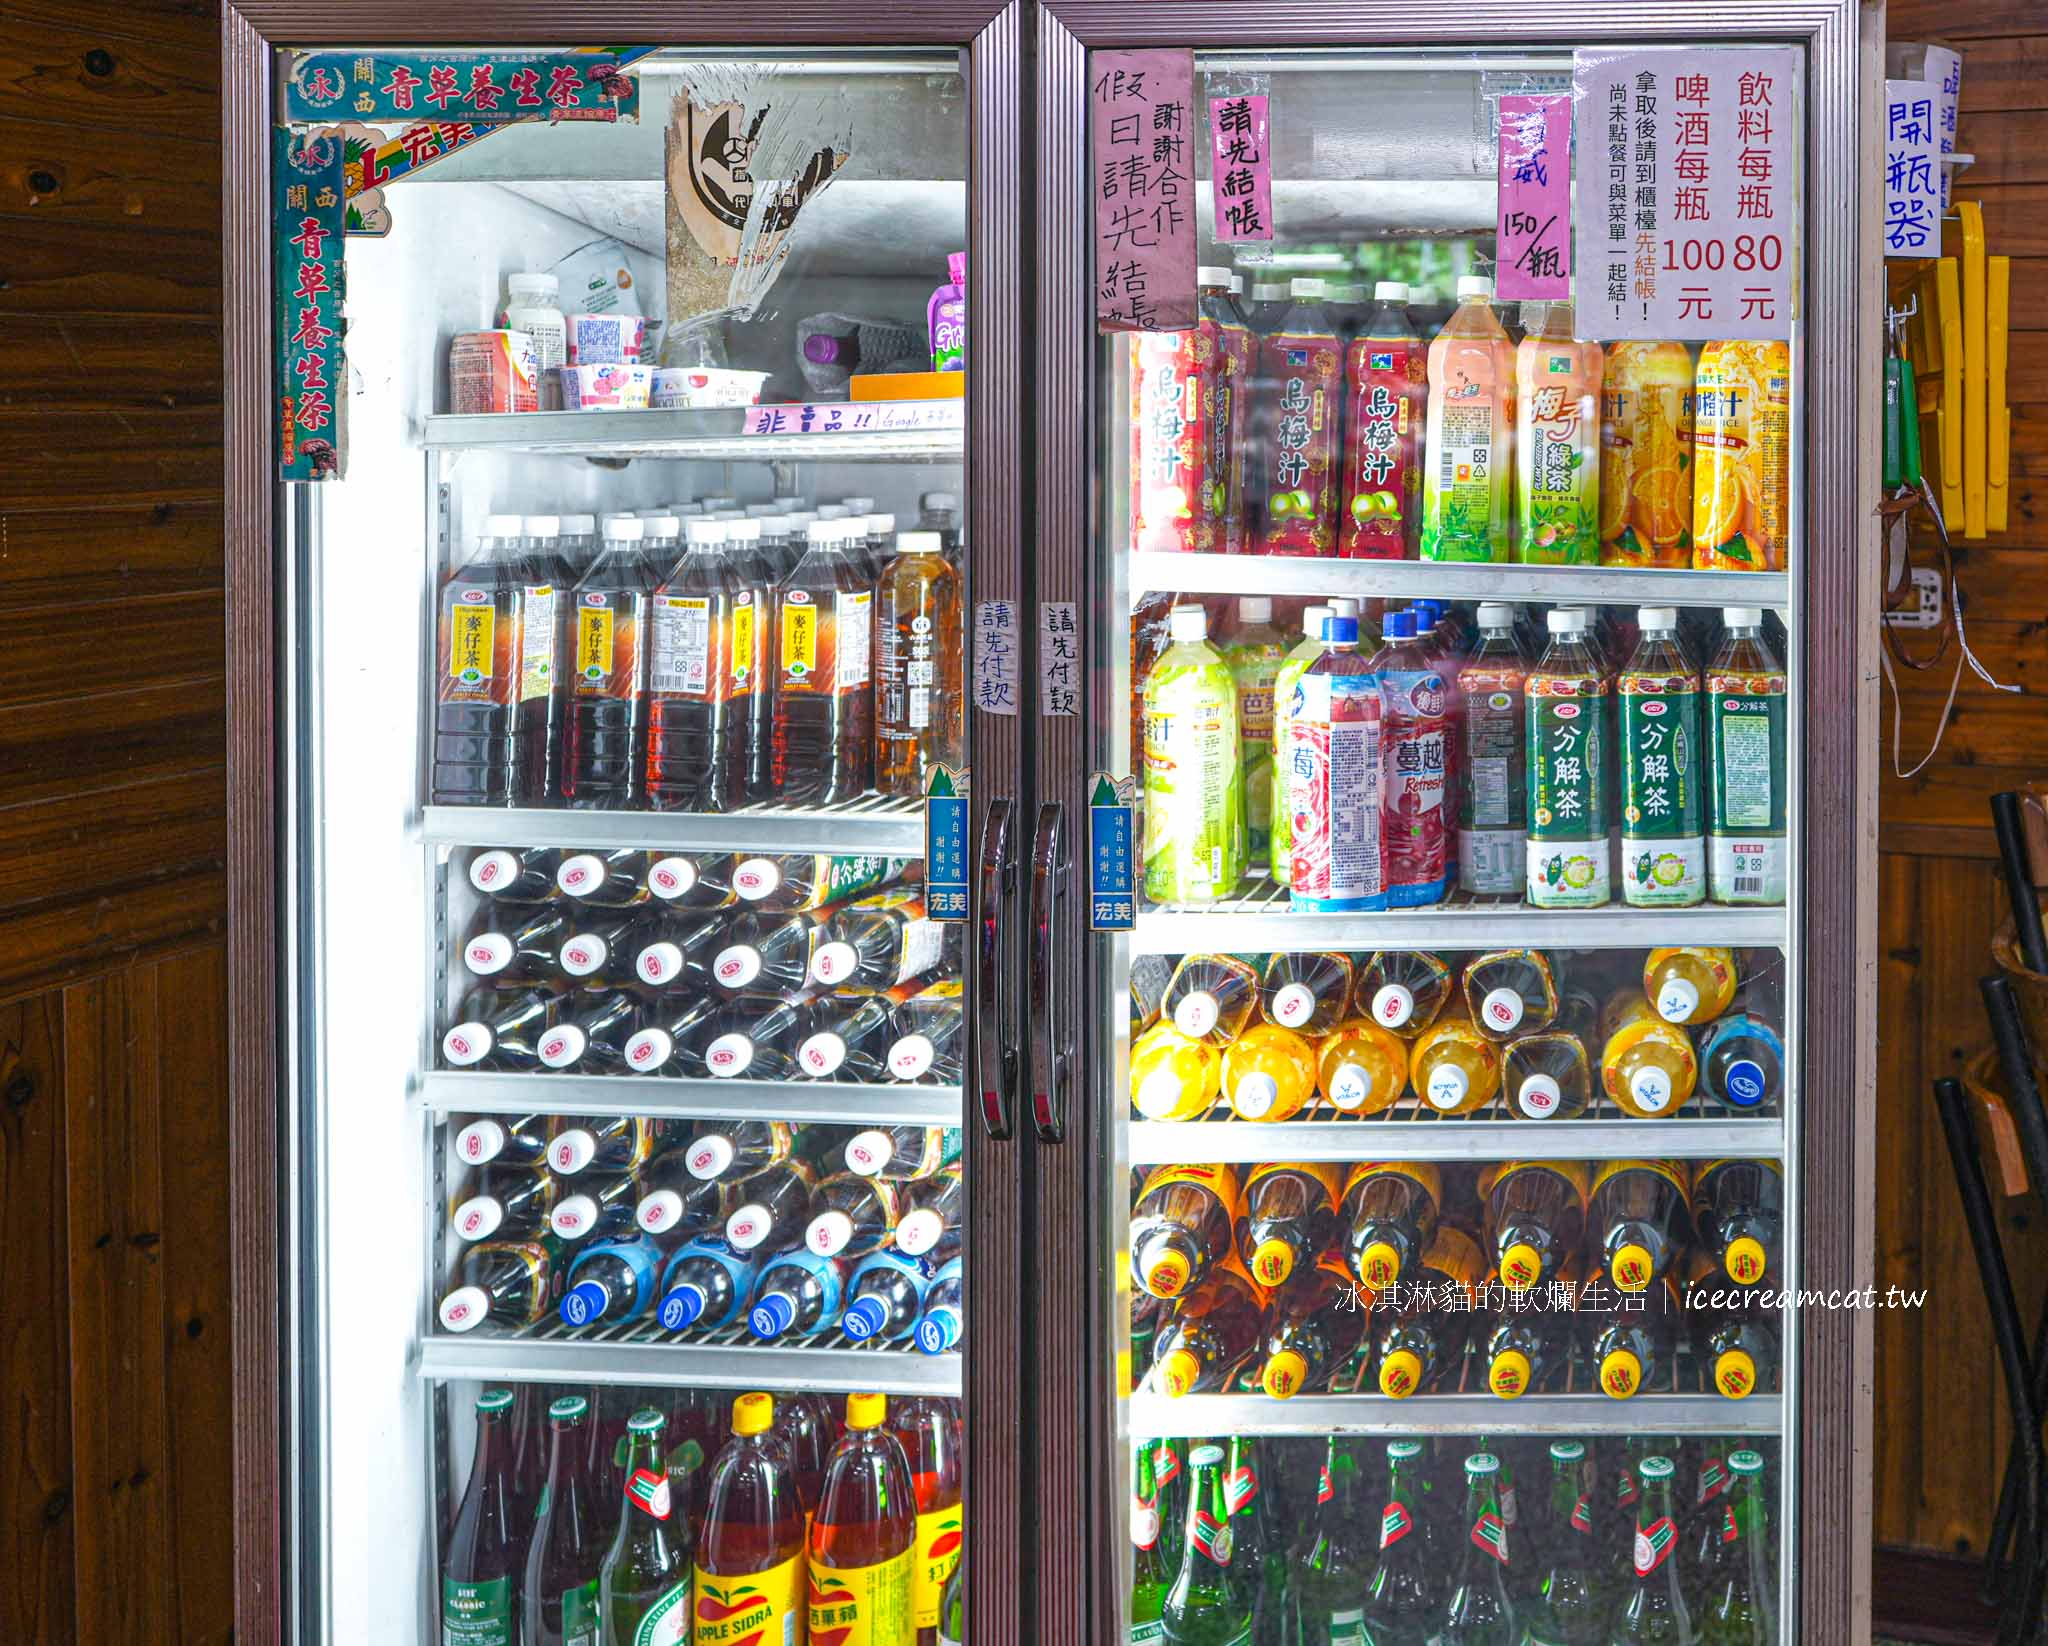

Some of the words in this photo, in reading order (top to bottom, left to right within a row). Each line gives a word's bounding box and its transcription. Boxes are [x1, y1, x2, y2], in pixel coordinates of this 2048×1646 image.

[306, 68, 339, 102] 永
[353, 57, 376, 114] 關西
[382, 64, 584, 111] 青草養生茶
[1149, 100, 1187, 236] 謝謝合作
[1217, 98, 1263, 236] 請先結帳
[1674, 73, 1711, 222] 啤酒每瓶
[1737, 71, 1774, 221] 飲料每瓶
[1885, 99, 1936, 249] 開瓶器
[286, 186, 338, 212] 關西
[1094, 71, 1159, 331] 假日請先結帳
[1662, 238, 1725, 272] 100
[1733, 233, 1783, 272] 80
[290, 218, 333, 431] 青草養生茶
[1678, 287, 1713, 320] 元
[1740, 287, 1776, 320] 元
[1153, 366, 1184, 482] 烏梅汁
[1277, 376, 1312, 487] 烏梅汁
[1363, 386, 1398, 485] 烏梅汁
[464, 616, 481, 667] 麥仔茶
[588, 617, 603, 665] 麥仔茶
[793, 614, 806, 661] 麥仔茶
[979, 602, 1015, 707] 請先付款
[1047, 608, 1079, 715] 請先付款
[1553, 725, 1582, 819] 分解茶
[1640, 722, 1670, 817] 分解茶
[930, 892, 967, 912] 宏美
[1094, 901, 1132, 921] 宏美
[697, 1620, 730, 1641] APPLE
[732, 1604, 773, 1635] SIDRA
